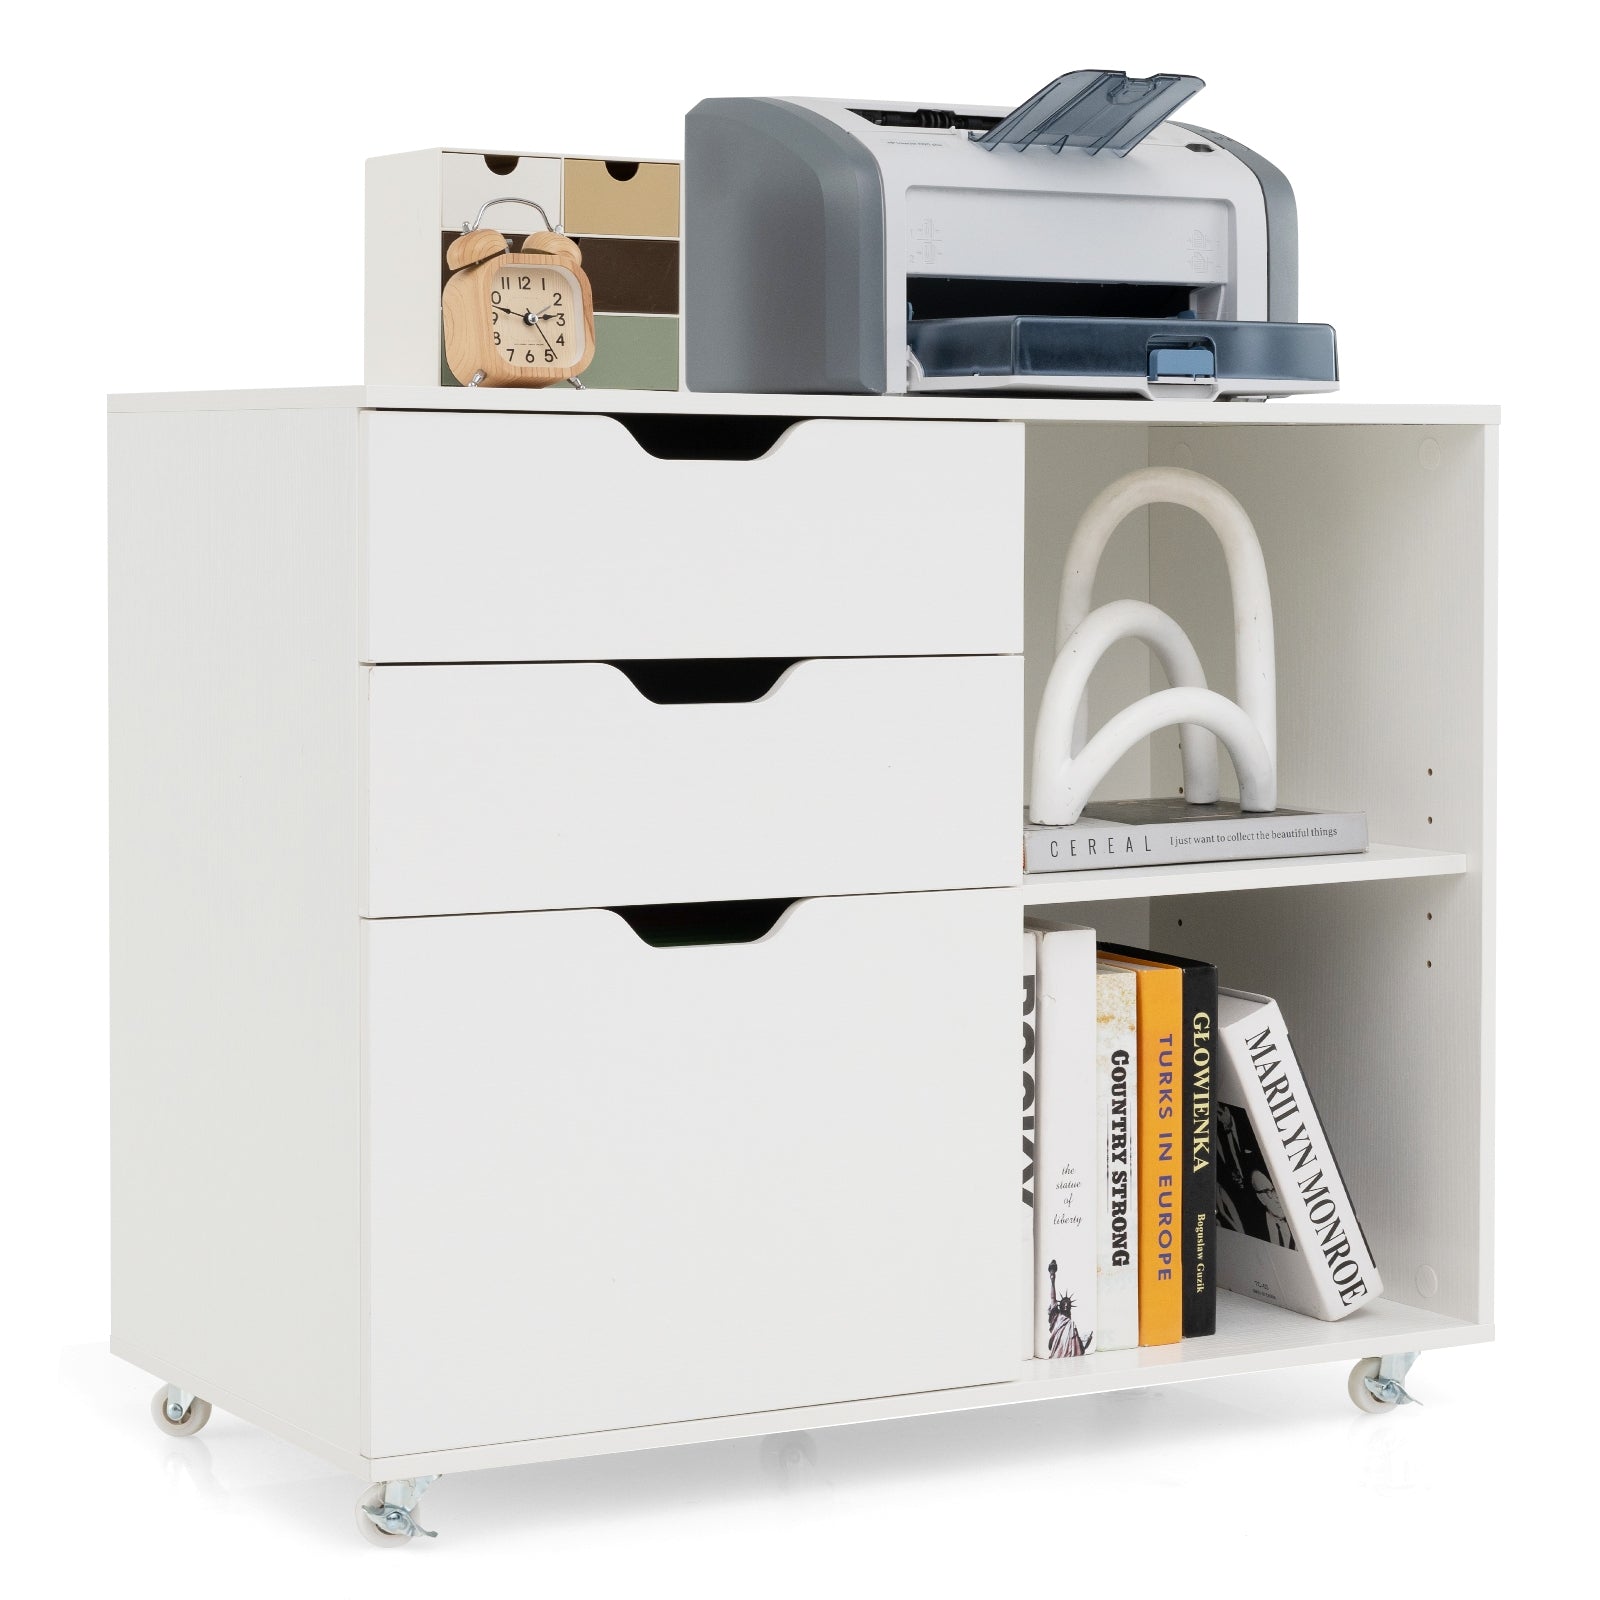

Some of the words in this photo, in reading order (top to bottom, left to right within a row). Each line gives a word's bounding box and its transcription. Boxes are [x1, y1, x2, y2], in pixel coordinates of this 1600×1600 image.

[501, 276, 510, 290] 11
[517, 276, 531, 290] 12
[541, 277, 546, 291] 1
[491, 290, 502, 305] 0
[553, 292, 562, 306] 2
[556, 313, 566, 327] 3
[493, 331, 502, 346] 8
[556, 333, 565, 347] 4
[506, 348, 515, 362] 7
[525, 349, 535, 364] 6
[544, 348, 554, 363] 5
[1174, 836, 1192, 848] just
[1193, 835, 1215, 844] want
[1216, 833, 1226, 843] to
[1226, 832, 1255, 842] collect
[1256, 830, 1270, 841] the
[1271, 828, 1310, 840] beautiful
[1310, 827, 1338, 838] things
[1050, 835, 1152, 858] CEREAL
[1158, 1033, 1173, 1120] TURKS
[1111, 1049, 1130, 1165] COUNTRY
[1158, 1132, 1173, 1161] IN
[1061, 1163, 1075, 1176] the
[1244, 1026, 1318, 1173] MARILYN
[1298, 1168, 1369, 1307] MONROE
[1055, 1180, 1081, 1190] statue
[1063, 1192, 1073, 1208] of
[1053, 1213, 1082, 1227] liberty
[1111, 1170, 1130, 1267] STRONG
[1158, 1175, 1173, 1281] EUROPE
[1196, 1262, 1205, 1294] Guzik
